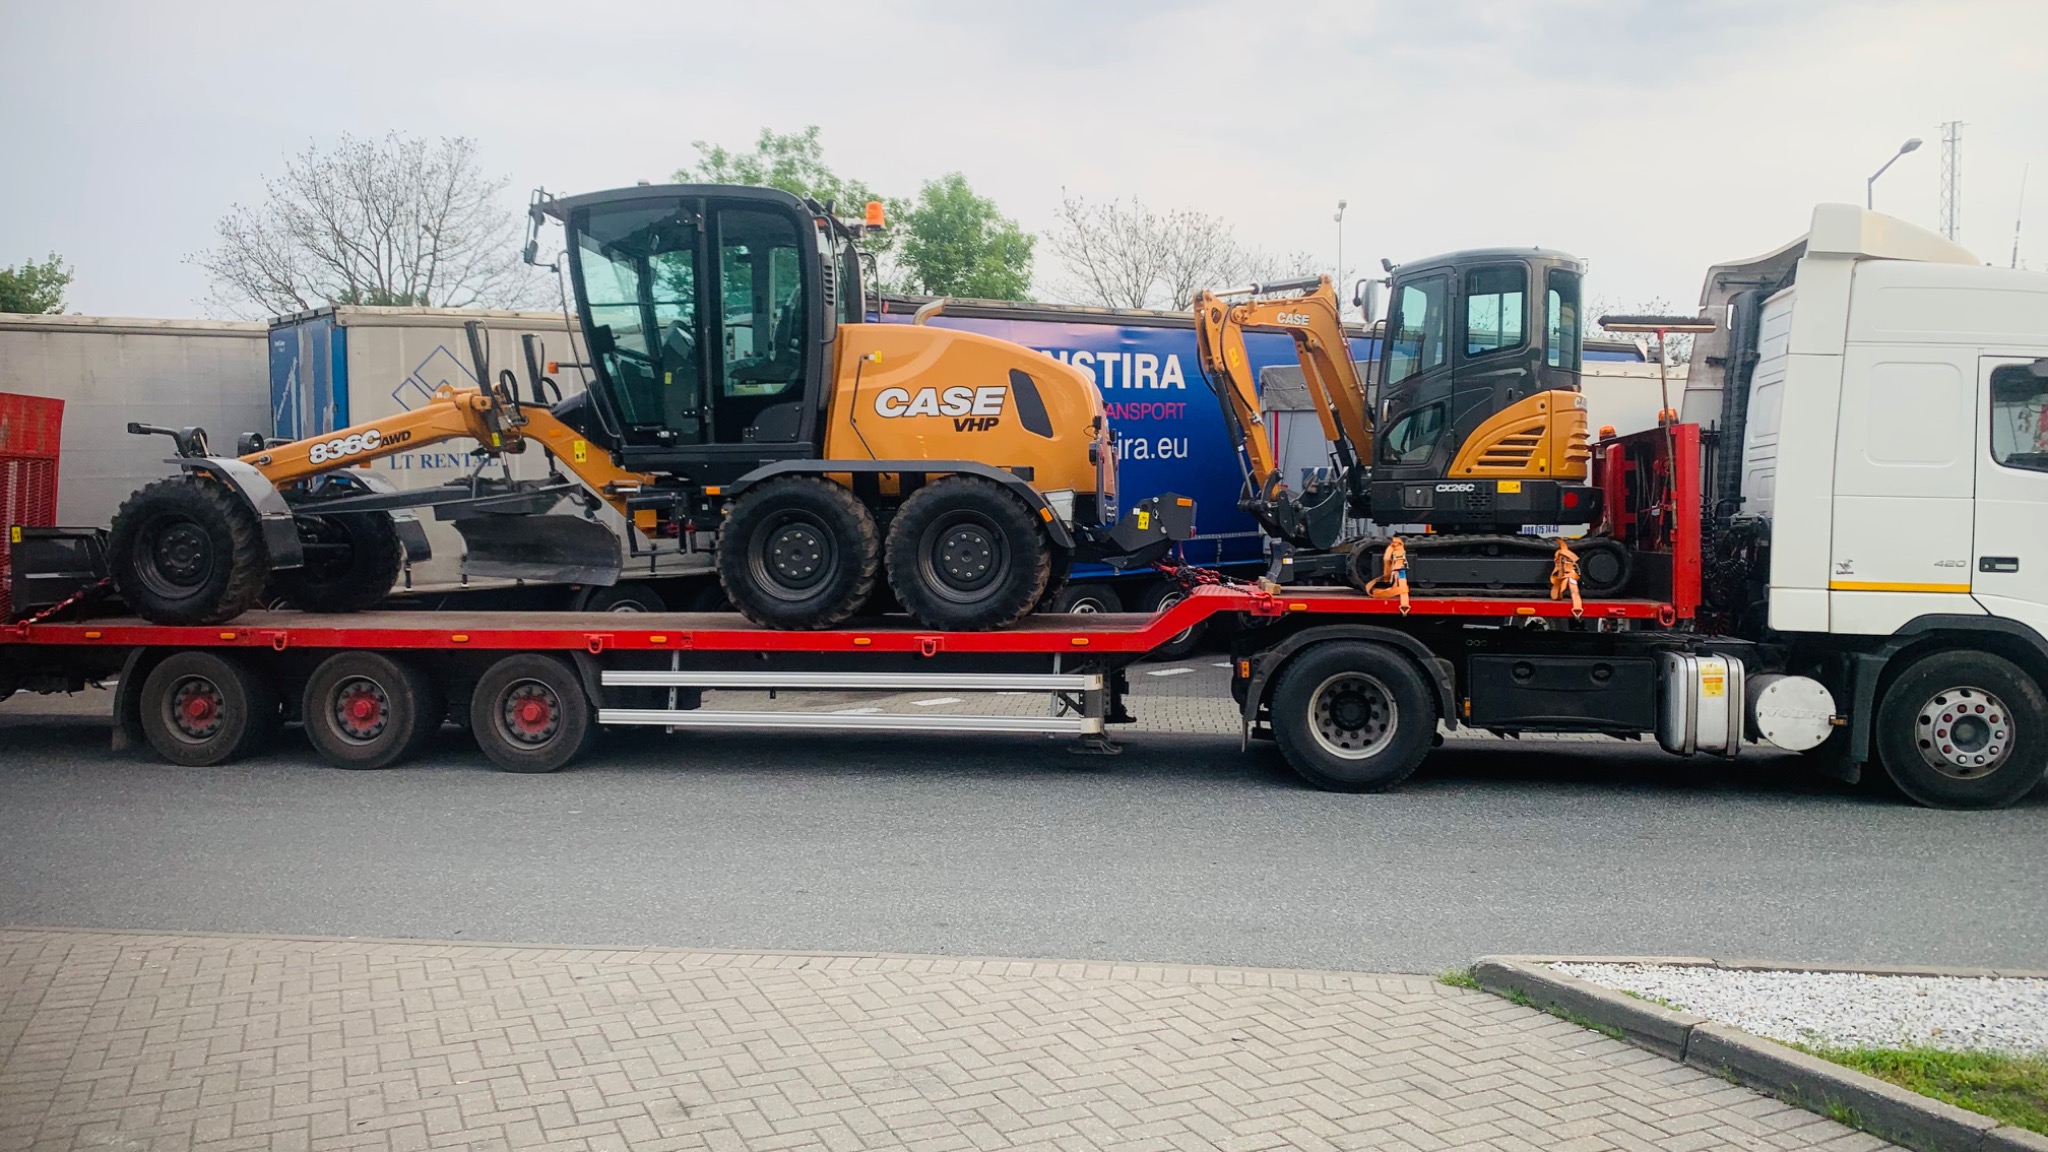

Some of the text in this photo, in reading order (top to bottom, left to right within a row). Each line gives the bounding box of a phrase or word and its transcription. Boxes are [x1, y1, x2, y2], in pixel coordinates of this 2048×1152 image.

[1276, 312, 1310, 326] CASE
[874, 386, 1008, 418] CASE
[953, 417, 1000, 432] VHP
[309, 429, 412, 464] 836C AWD
[390, 453, 414, 470] LT
[1435, 483, 1476, 493] CX26C
[1933, 560, 1967, 568] 420
